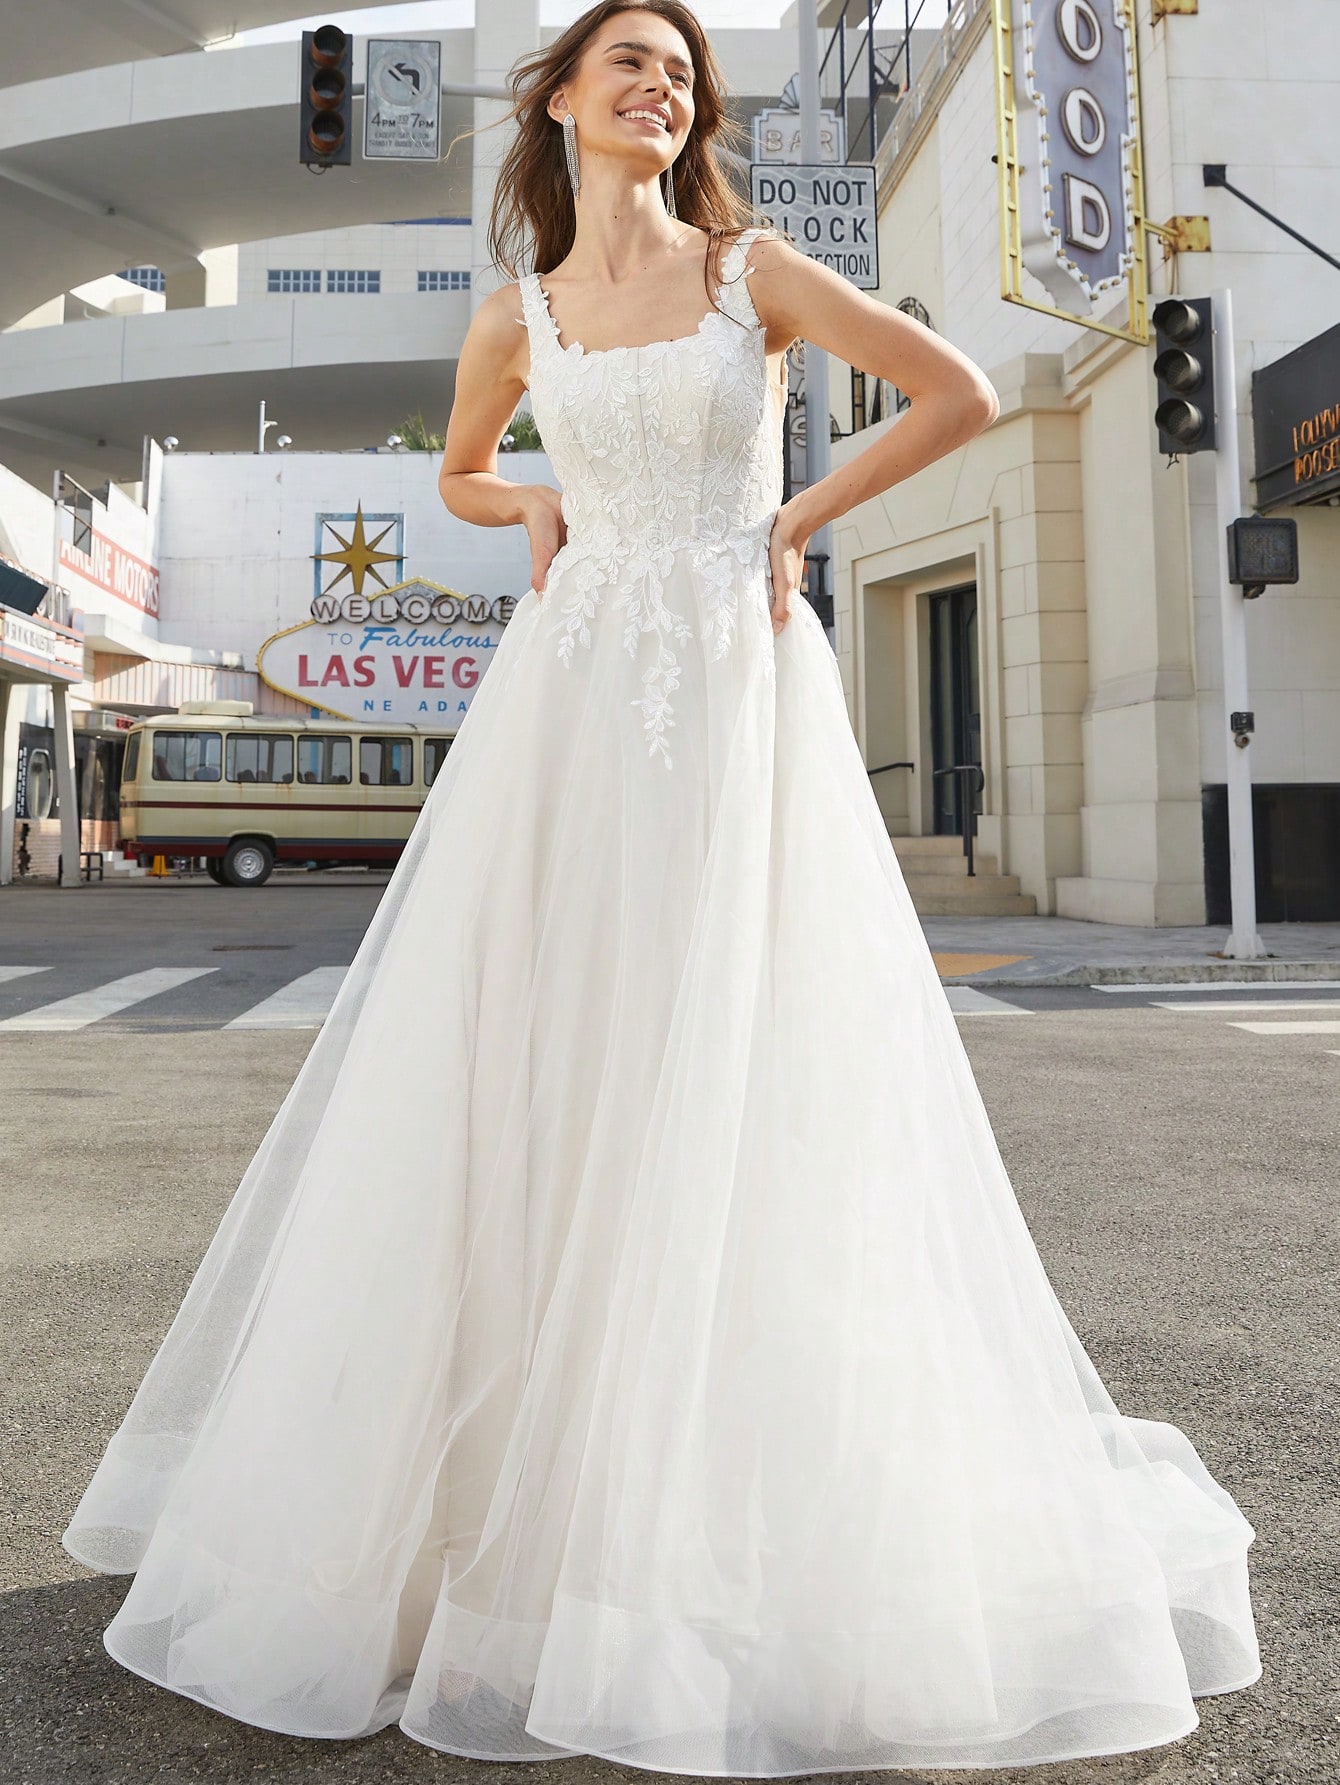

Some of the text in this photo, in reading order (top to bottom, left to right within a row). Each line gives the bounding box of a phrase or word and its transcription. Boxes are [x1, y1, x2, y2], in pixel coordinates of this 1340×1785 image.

[371, 112, 396, 127] 4PM
[410, 113, 434, 128] 7PM
[759, 179, 867, 206] DO NOT
[760, 216, 868, 243] LOCK
[114, 549, 159, 614] MOTORS
[313, 598, 514, 620] WELCOME
[327, 626, 498, 651] TO Fabulous
[298, 654, 375, 688] LAS
